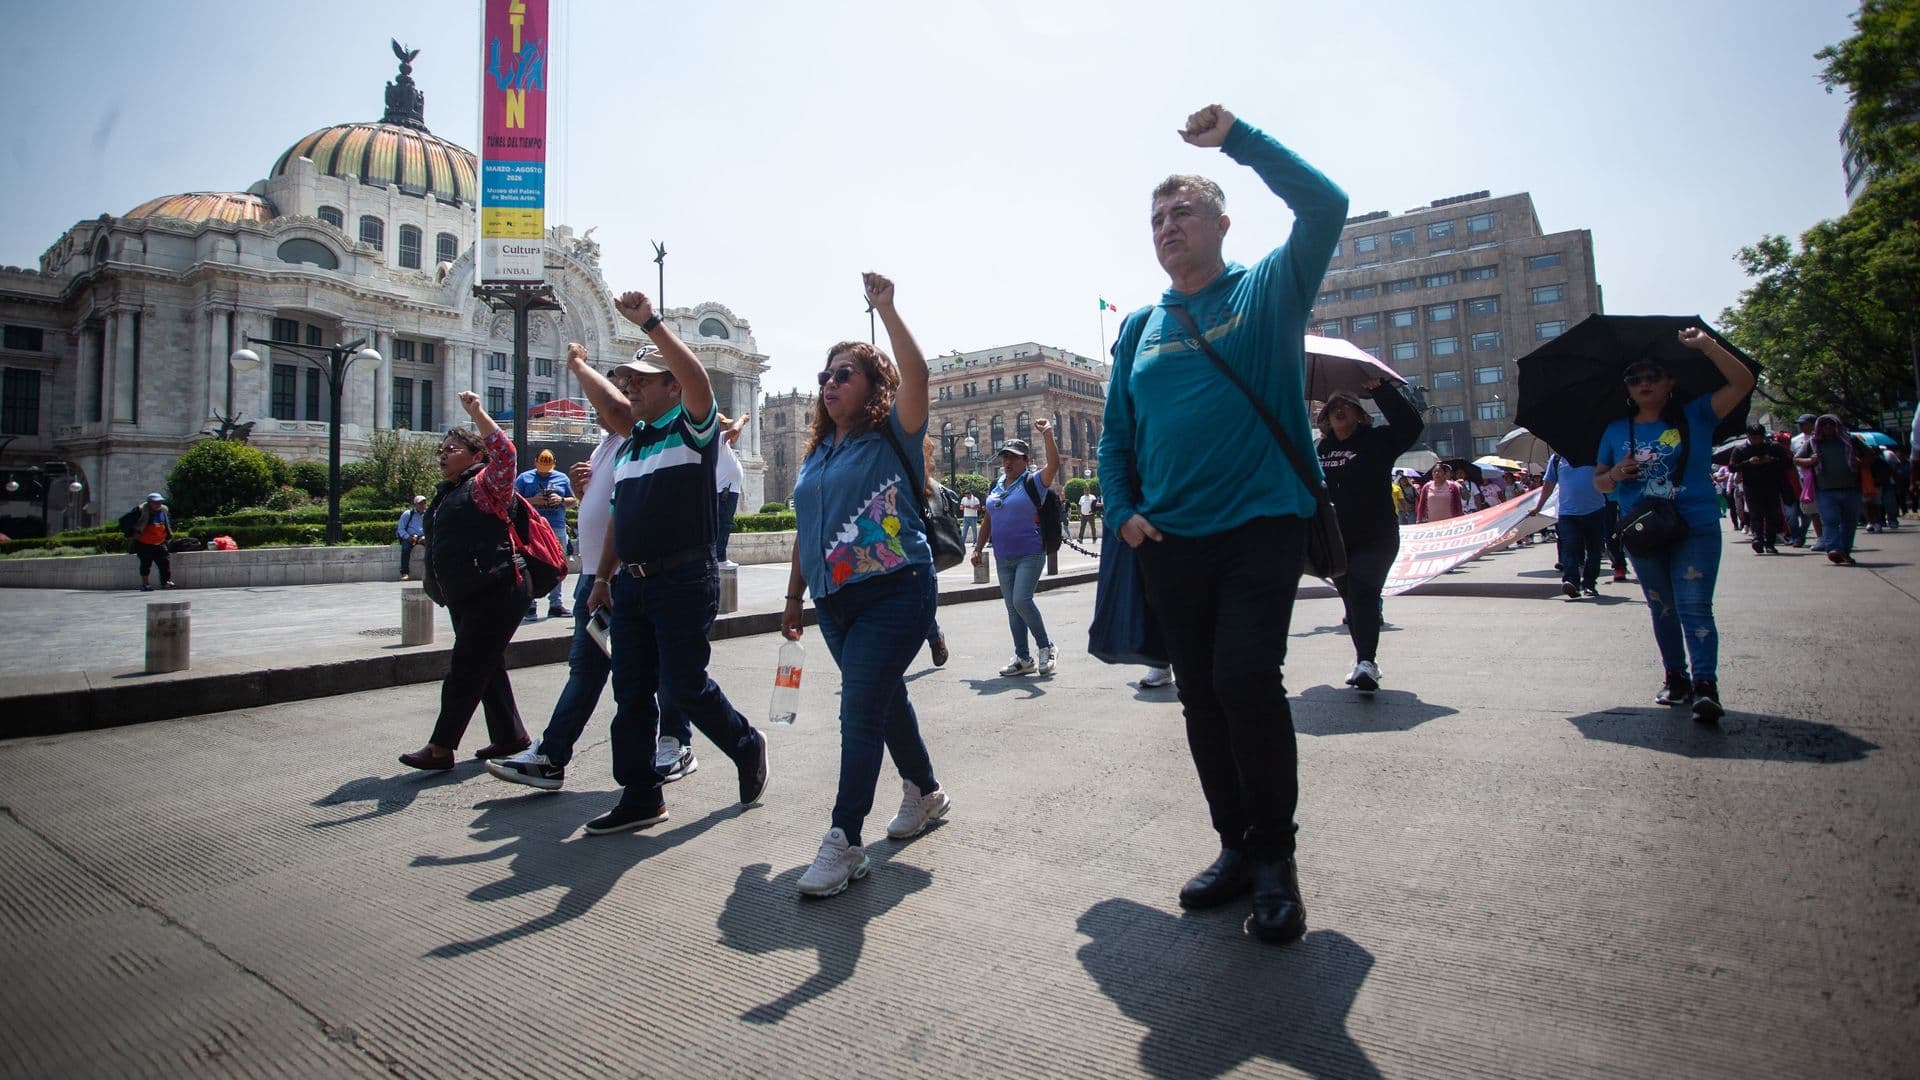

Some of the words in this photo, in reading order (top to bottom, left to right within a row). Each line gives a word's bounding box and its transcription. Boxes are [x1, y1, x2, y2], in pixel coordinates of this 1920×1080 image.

[507, 136, 518, 148] DEL
[519, 137, 542, 150] TIEMPO
[502, 245, 541, 255] Cultura
[503, 266, 531, 275] INBAL
